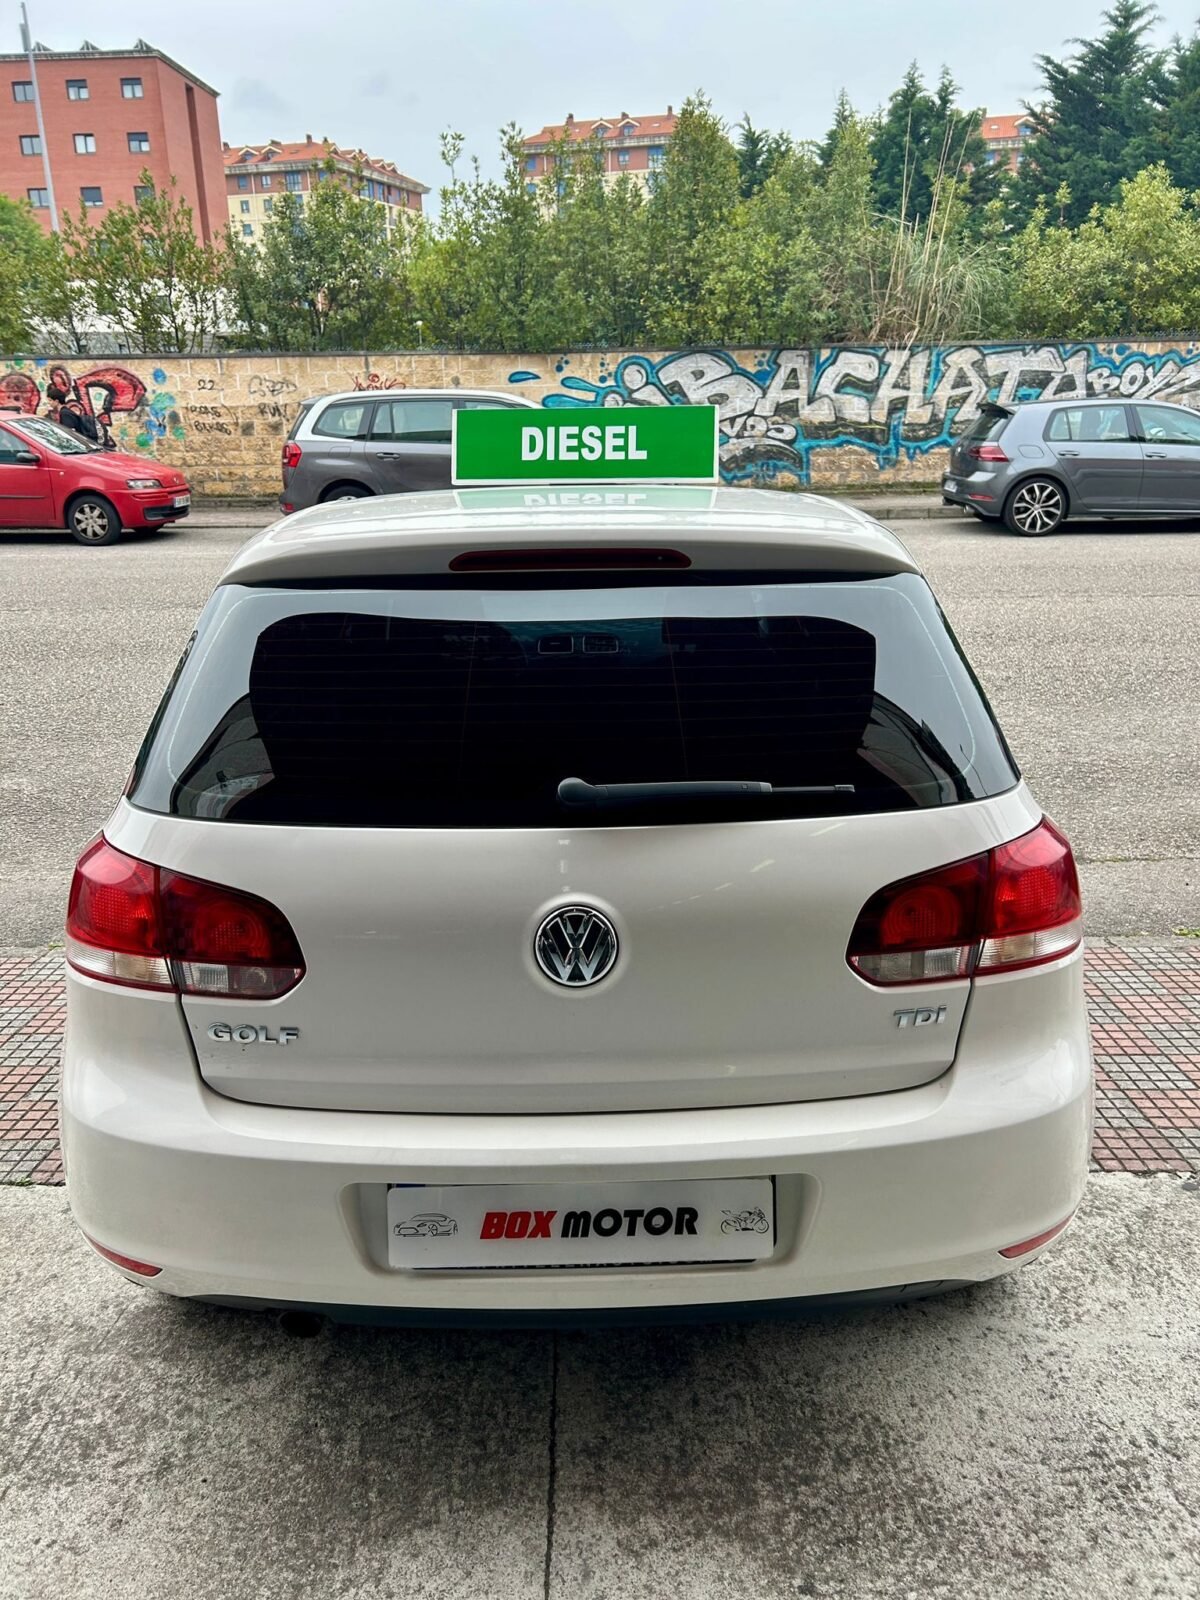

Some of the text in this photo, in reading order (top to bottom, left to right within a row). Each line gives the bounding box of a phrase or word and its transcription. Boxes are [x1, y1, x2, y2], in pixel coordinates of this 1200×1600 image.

[521, 425, 648, 461] DIESEL
[893, 1005, 947, 1028] TDI
[207, 1022, 299, 1045] GOLF
[479, 1206, 699, 1240] BOX MOTOR
